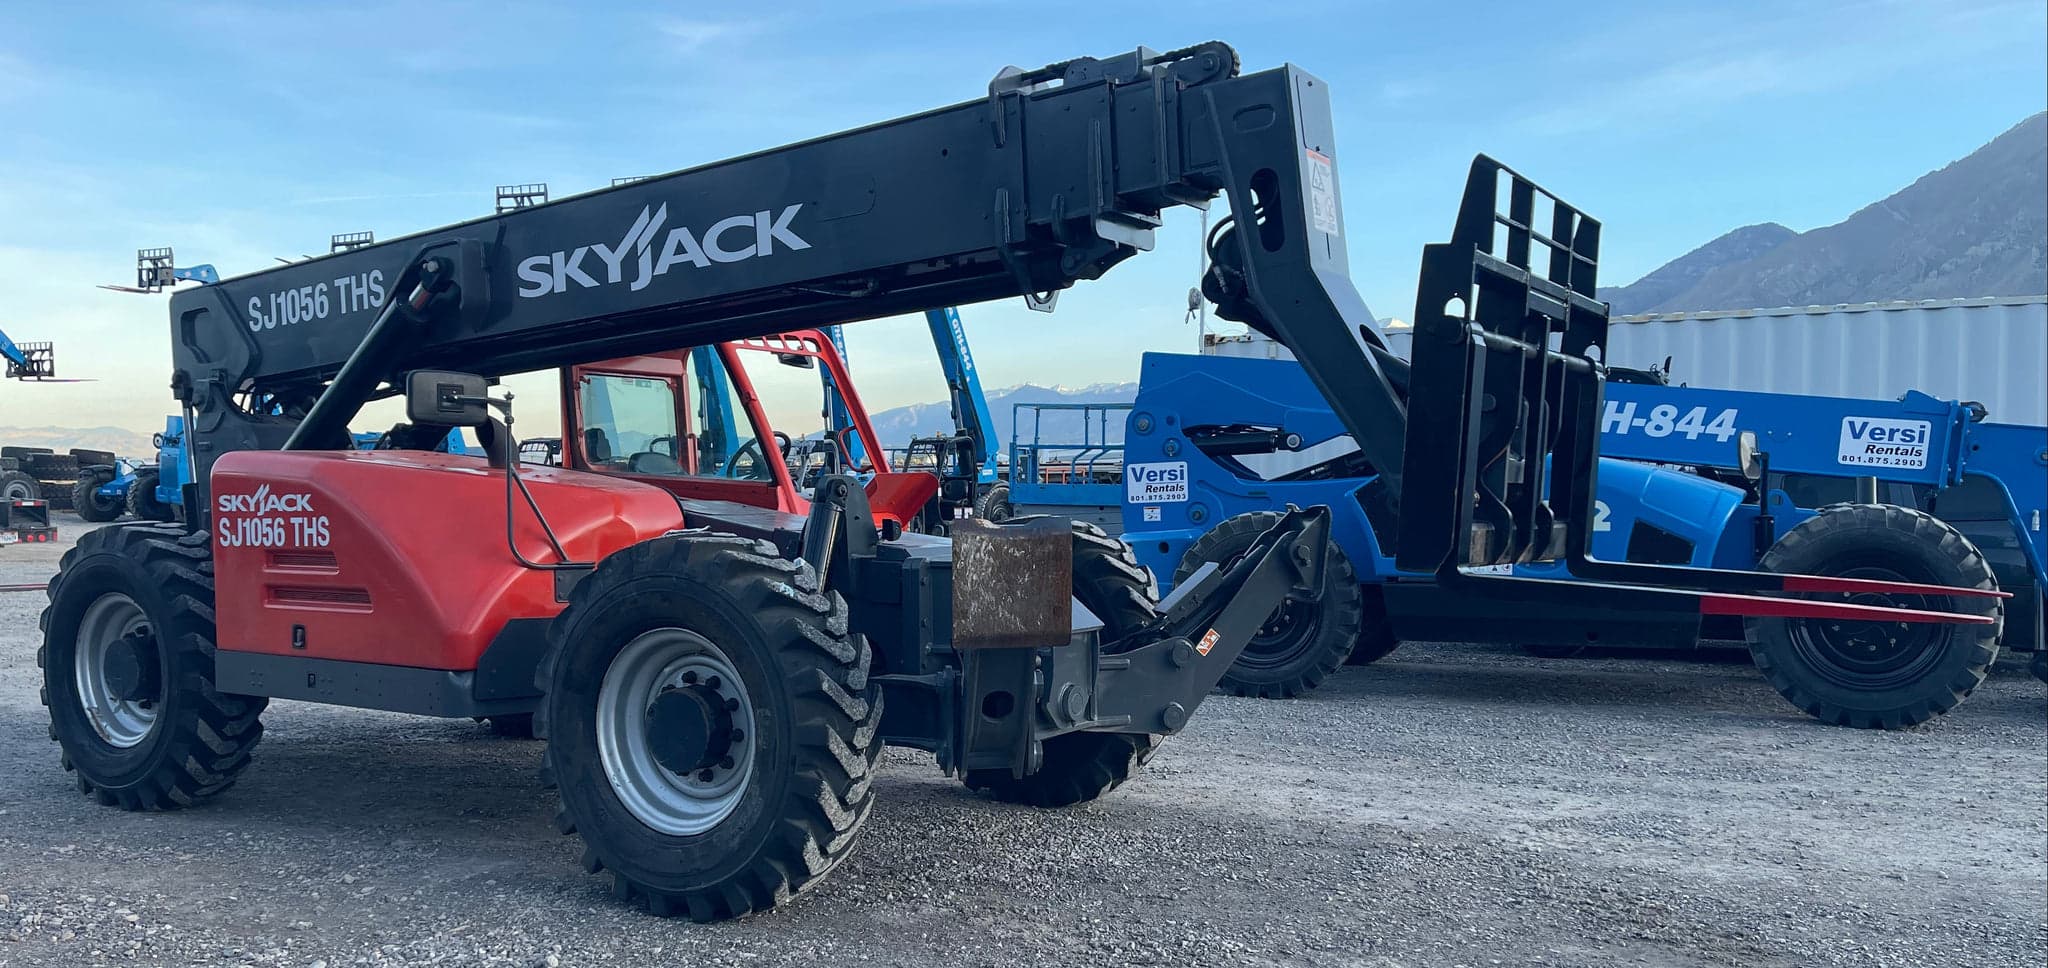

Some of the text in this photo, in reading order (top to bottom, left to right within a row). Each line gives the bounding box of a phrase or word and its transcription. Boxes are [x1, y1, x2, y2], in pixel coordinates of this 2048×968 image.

[517, 201, 813, 298] SKYJACK
[249, 269, 385, 332] SJ1056 THS
[951, 318, 972, 371] GTH-844
[1601, 400, 1738, 442] H-844
[1848, 420, 1926, 444] Versi
[1841, 455, 1923, 467] 801.875.2903
[1865, 444, 1923, 457] Rentals
[1130, 465, 1185, 482] Versi
[1145, 484, 1185, 493] Rentals
[218, 484, 314, 516] SKYJACK
[219, 516, 330, 547] SJ1056 THS
